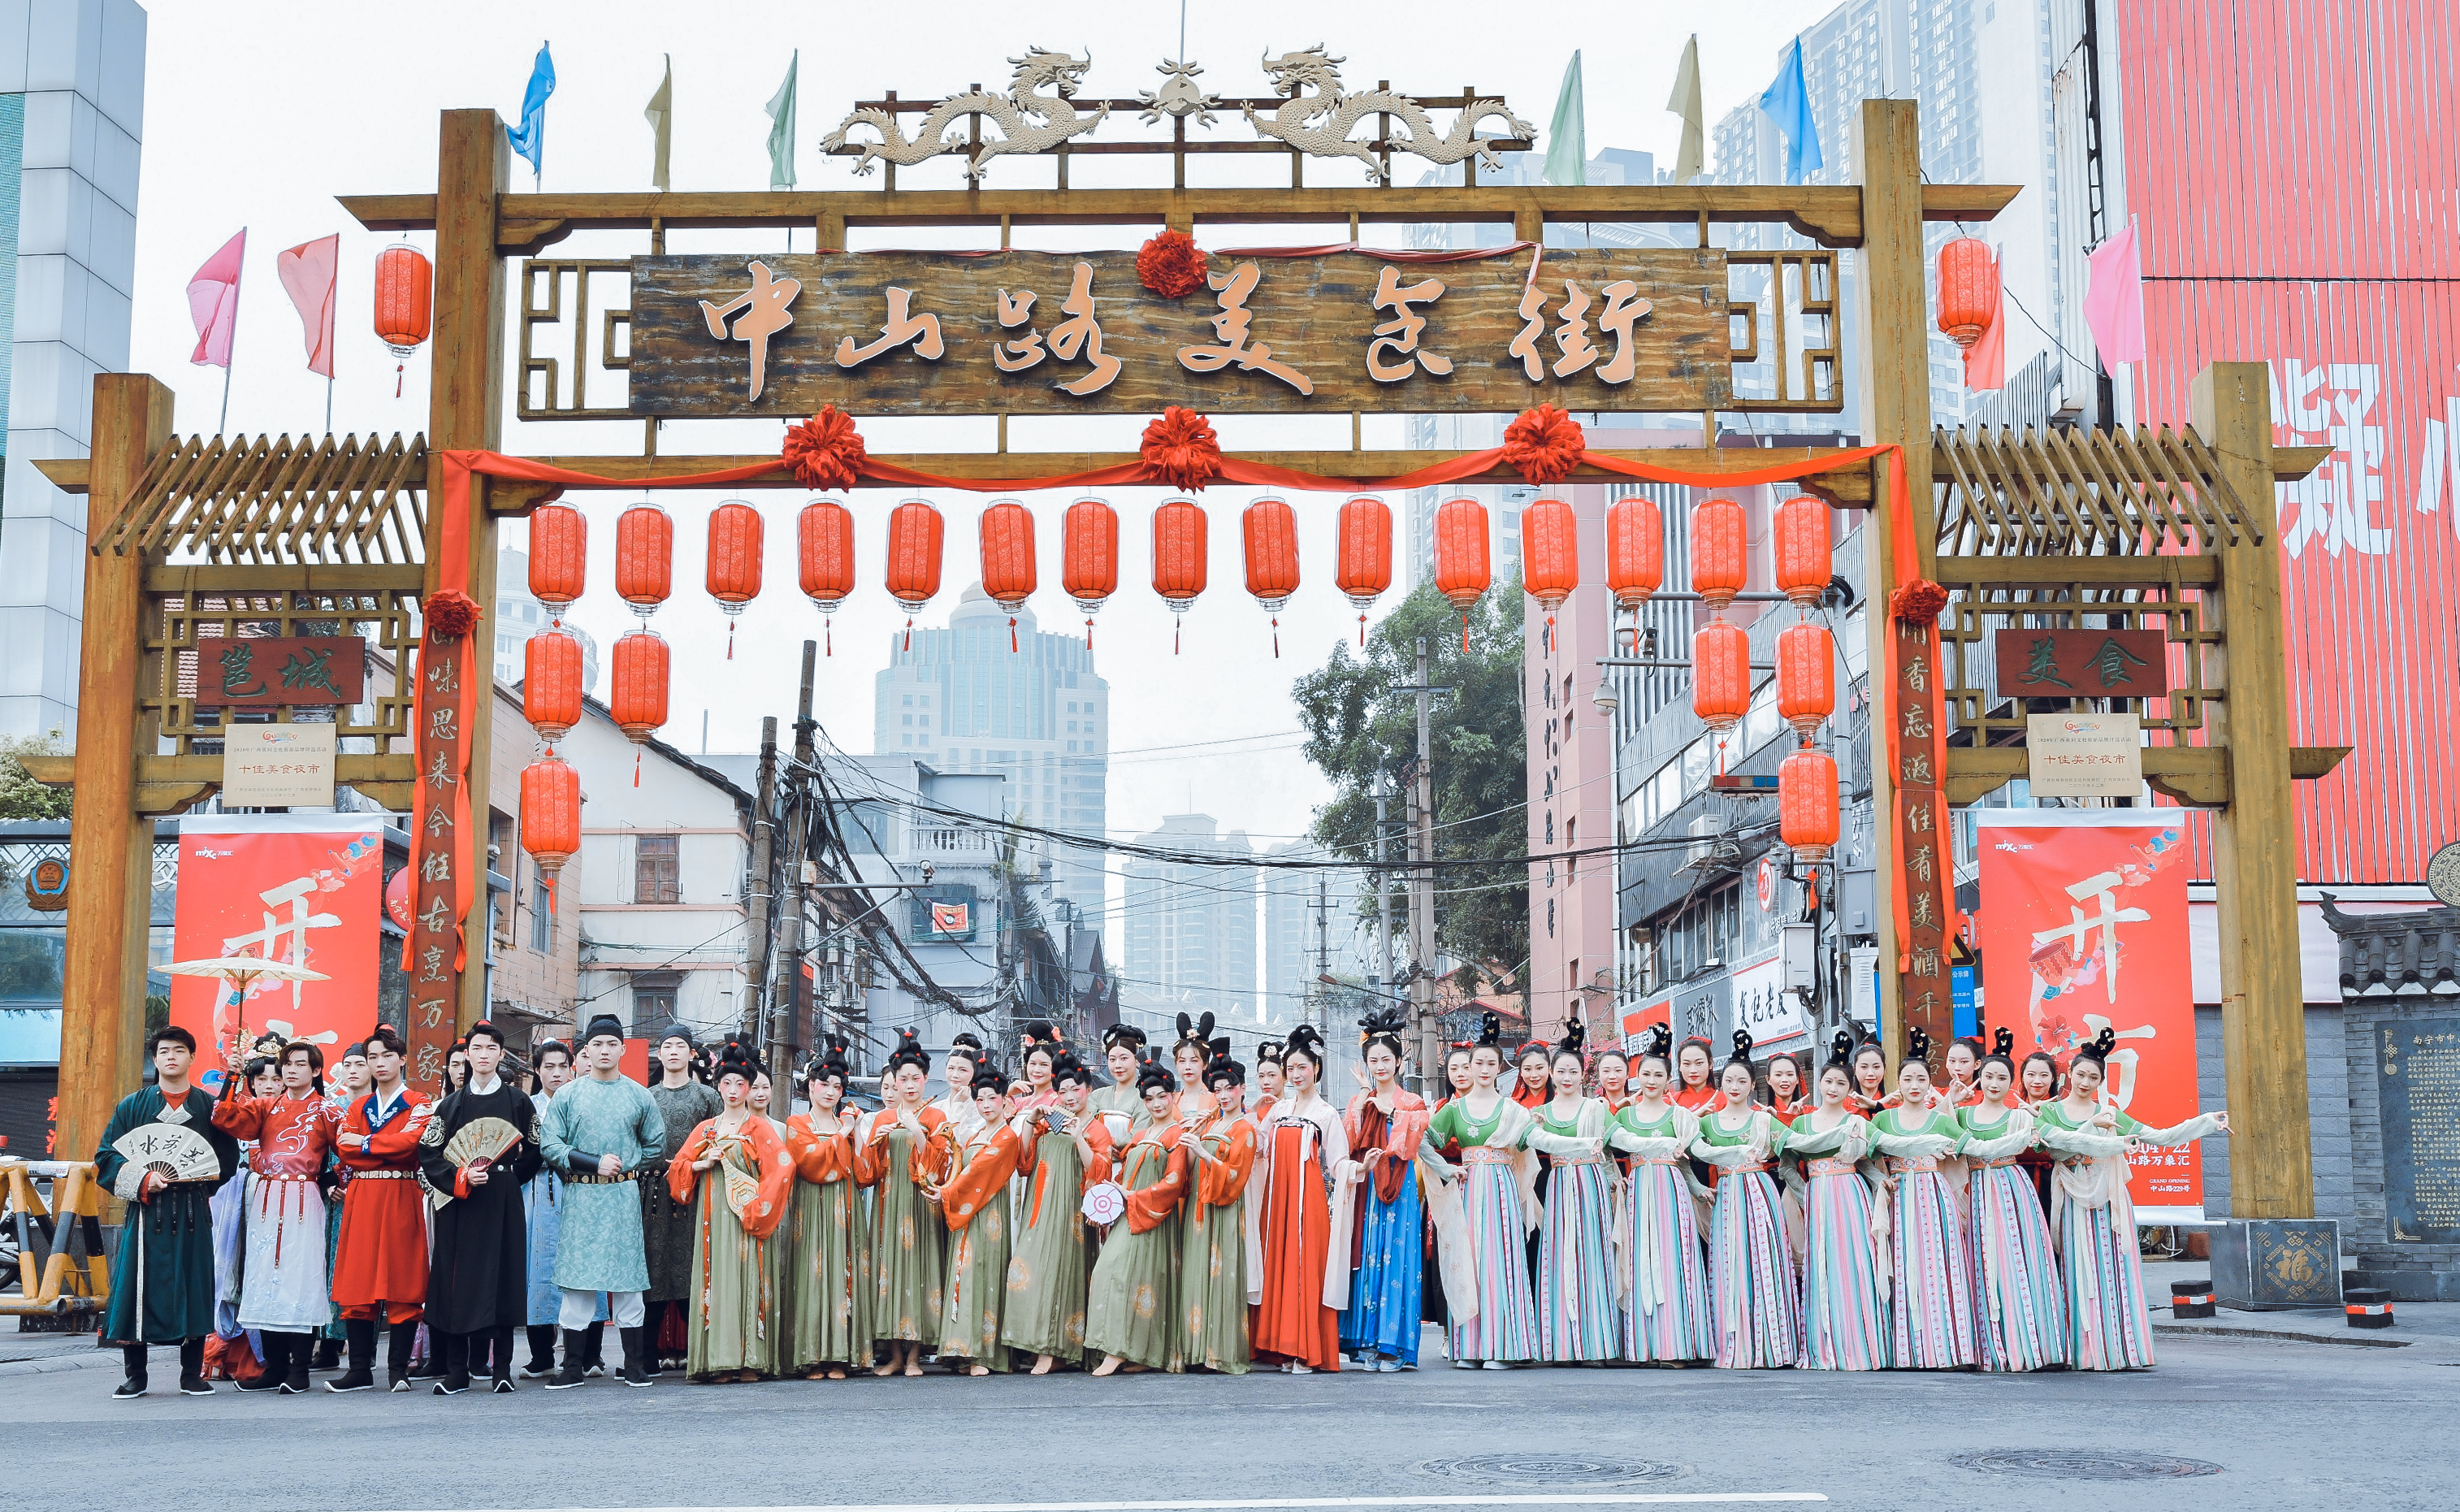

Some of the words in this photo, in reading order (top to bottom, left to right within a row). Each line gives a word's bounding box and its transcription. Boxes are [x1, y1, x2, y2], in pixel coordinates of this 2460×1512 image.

[698, 260, 1653, 401] 中山路美食街
[219, 642, 340, 698] 邕城
[2017, 635, 2148, 689] 美食
[238, 764, 320, 774] 十佳美食夜市
[2044, 754, 2126, 765] 十佳美食夜市
[2150, 1185, 2191, 1193] 中山路229号
